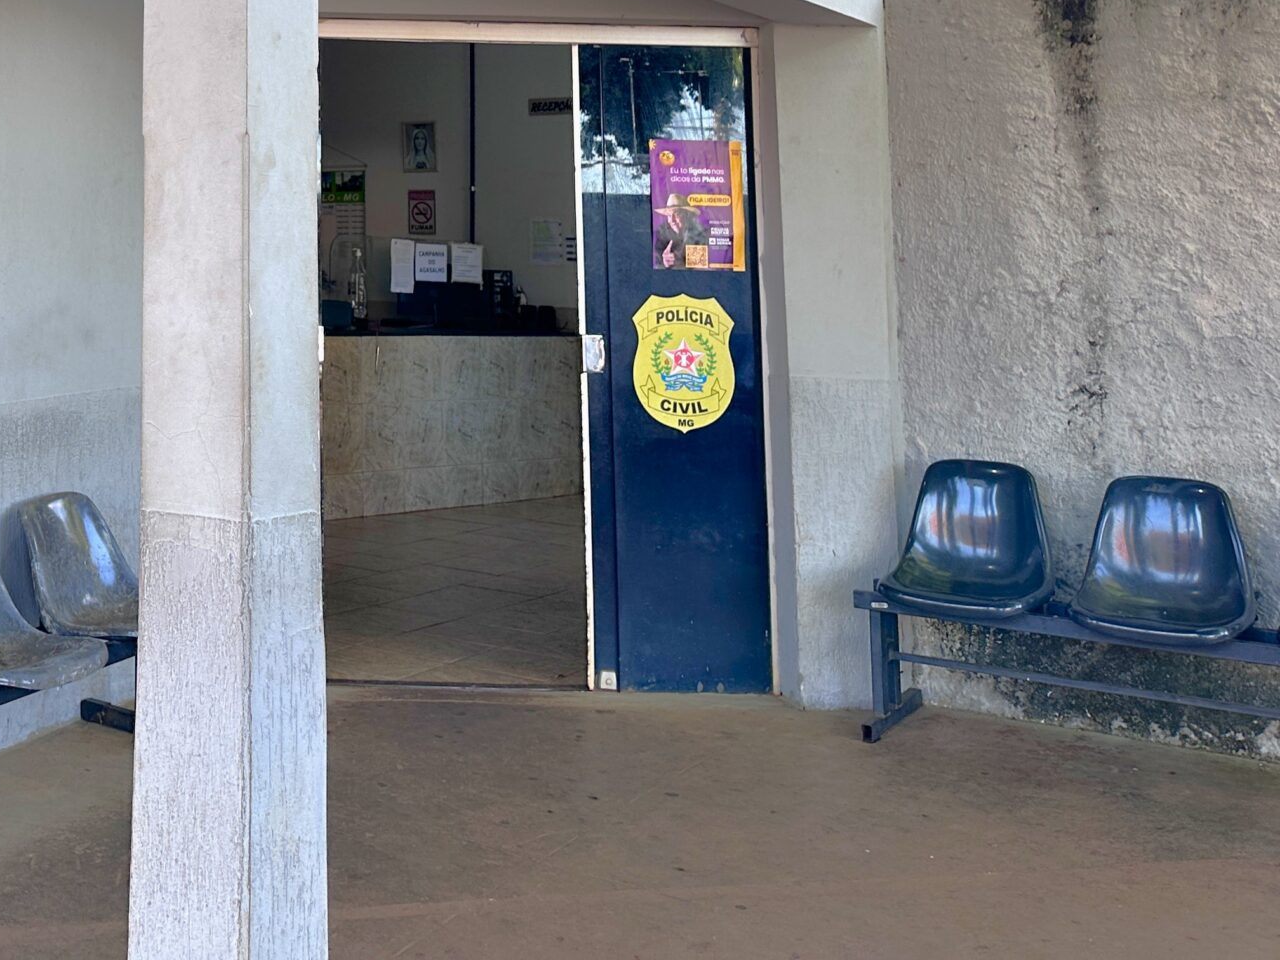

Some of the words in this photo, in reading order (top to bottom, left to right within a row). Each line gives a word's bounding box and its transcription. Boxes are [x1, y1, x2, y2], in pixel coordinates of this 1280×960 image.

[689, 167, 711, 176] ligado
[343, 193, 360, 202] MG
[656, 307, 714, 328] POLÍCIA
[660, 399, 708, 415] CIVIL
[678, 419, 695, 428] MG
